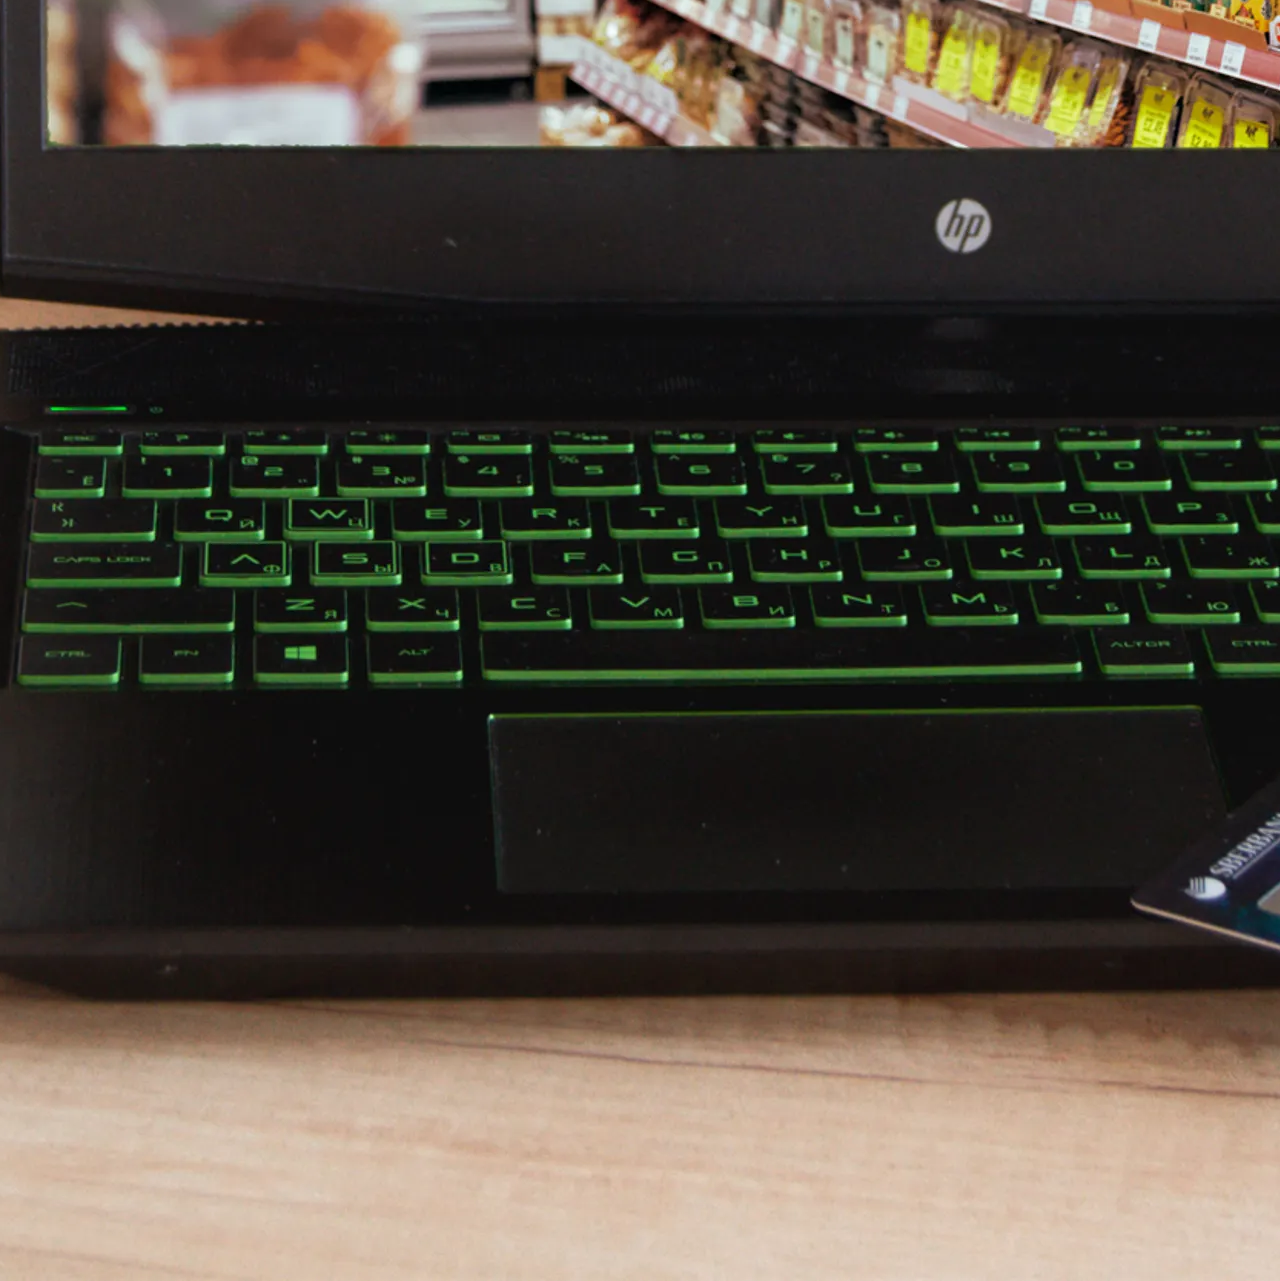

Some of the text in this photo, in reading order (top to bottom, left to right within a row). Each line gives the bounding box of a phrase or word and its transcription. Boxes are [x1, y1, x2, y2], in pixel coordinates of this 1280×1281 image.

[941, 199, 987, 253] hp
[373, 466, 391, 475] 3
[478, 466, 498, 475] 4
[584, 465, 604, 475] 5
[689, 465, 711, 474] 6
[796, 463, 815, 474] 7
[901, 463, 922, 472] 8
[1008, 462, 1030, 471] 9
[1113, 461, 1135, 470] 0
[164, 467, 173, 477] 1
[263, 466, 283, 477] 2
[640, 507, 665, 518] T
[746, 506, 773, 517] Y
[853, 505, 881, 516] U
[972, 504, 980, 515] I
[1068, 503, 1097, 514] O
[1177, 502, 1202, 513] P
[204, 509, 233, 522] Q
[309, 508, 347, 520] W
[425, 509, 446, 519] E
[531, 508, 557, 519] R
[342, 552, 369, 564] S
[451, 552, 480, 564] D
[563, 552, 585, 563] F
[672, 550, 699, 562] G
[780, 549, 808, 560] H
[899, 549, 911, 560] J
[1000, 547, 1023, 559] K
[1109, 547, 1132, 558] L
[511, 597, 535, 609] C
[620, 596, 649, 608] V
[733, 595, 759, 607] B
[842, 594, 873, 605] N
[951, 592, 986, 604] M
[286, 599, 314, 611] Z
[399, 598, 425, 610] X
[399, 648, 430, 656] ALT
